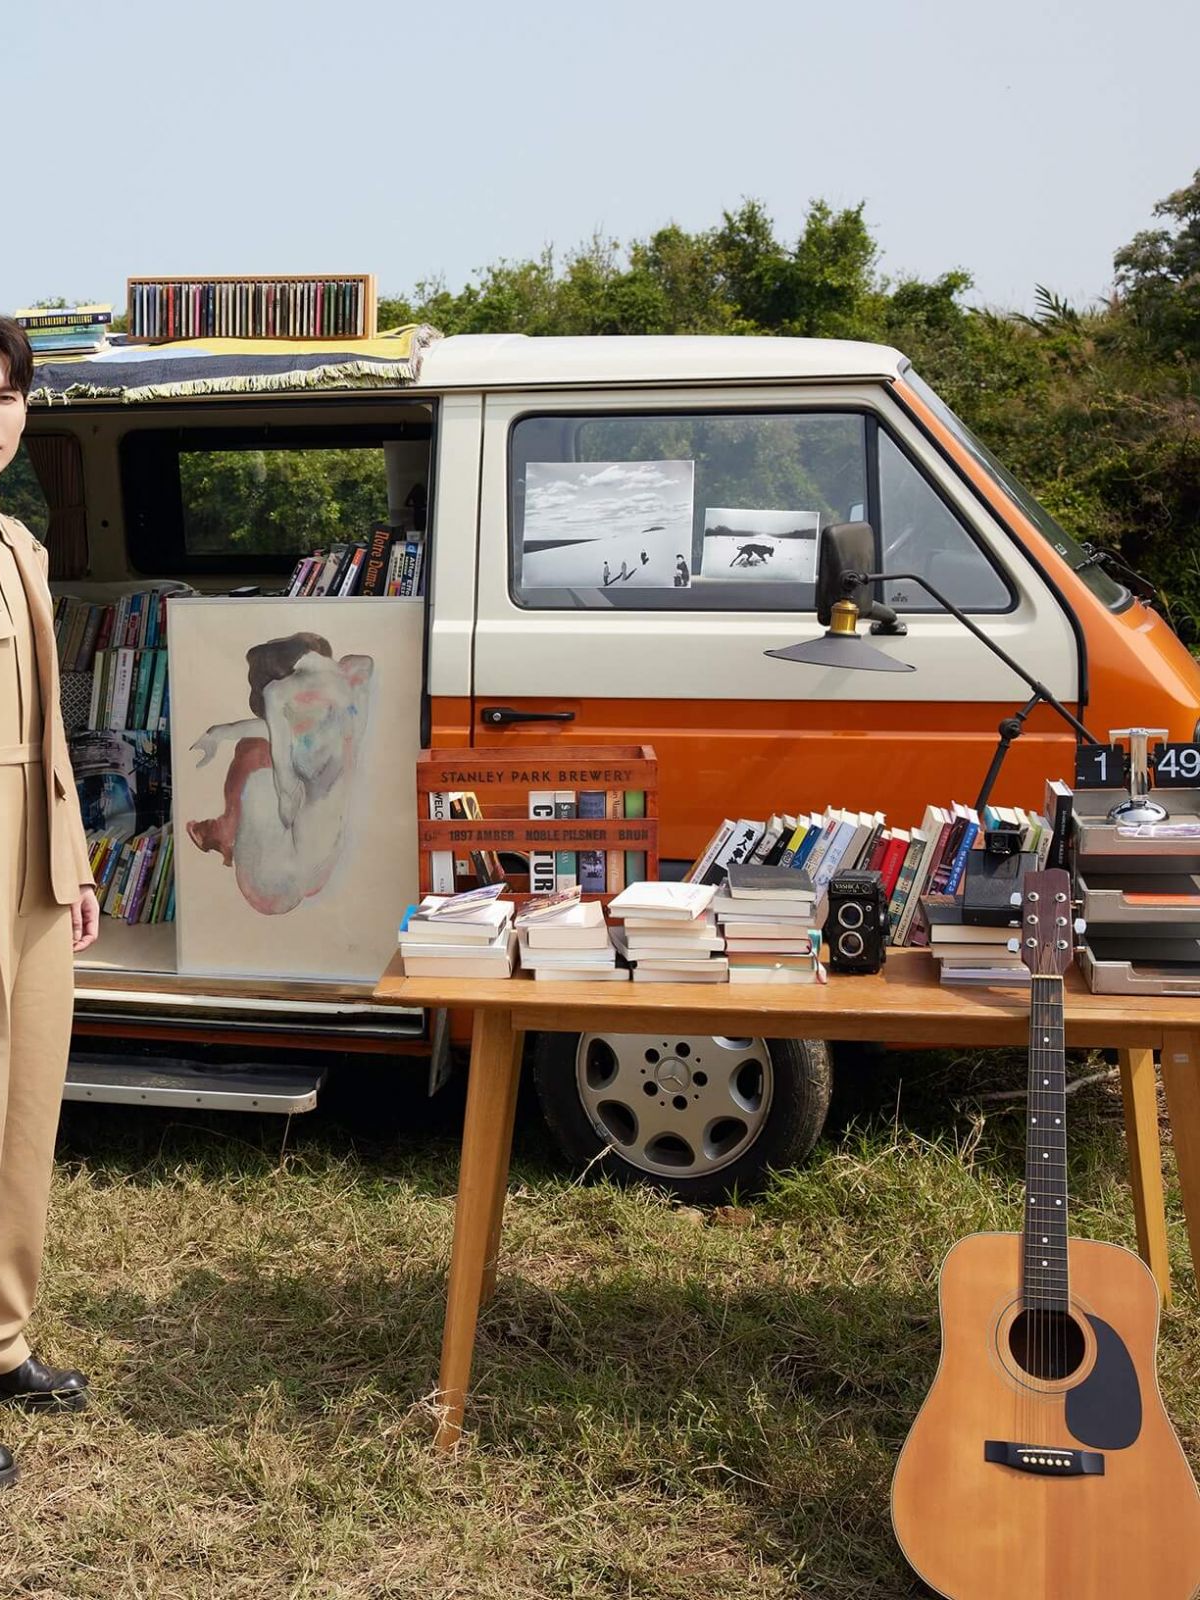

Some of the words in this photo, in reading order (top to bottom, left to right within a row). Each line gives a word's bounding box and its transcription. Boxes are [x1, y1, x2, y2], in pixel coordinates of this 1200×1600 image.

[1157, 748, 1200, 779] 49
[441, 770, 504, 784] STANLEY
[511, 769, 551, 783] PARK
[558, 769, 633, 783] BREWERY
[434, 792, 444, 820] WELC
[477, 830, 514, 842] AMBER
[526, 830, 560, 841] NOBLE
[562, 830, 607, 841] PILSNER
